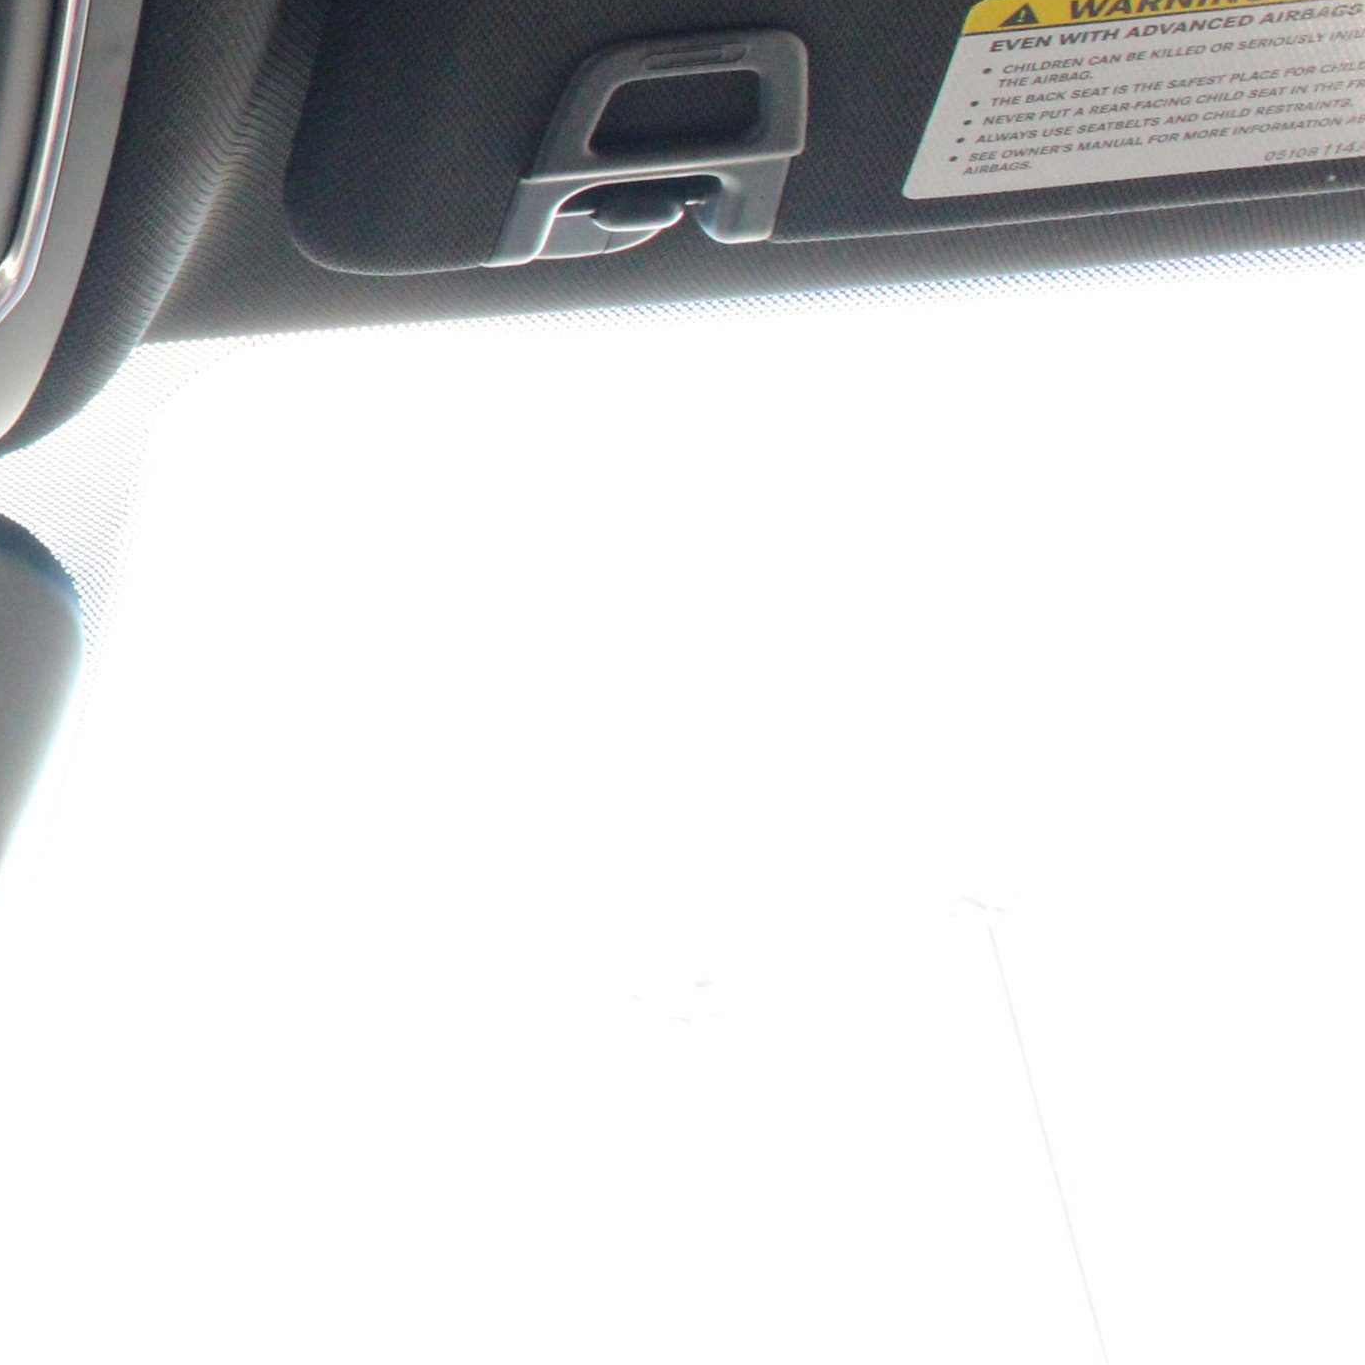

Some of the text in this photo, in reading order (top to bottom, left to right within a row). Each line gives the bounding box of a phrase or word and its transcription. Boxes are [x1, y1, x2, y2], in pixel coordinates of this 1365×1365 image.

[989, 3, 1365, 52] EVEN WITH ADVANCED AIRBAGS
[1003, 58, 1084, 74] CHILDREN
[1088, 53, 1121, 66] CAN
[1126, 50, 1147, 62] BE
[1150, 44, 1207, 59] KILLED
[1210, 42, 1234, 53] OR
[1237, 32, 1326, 50] SERIOUSLY
[991, 95, 1021, 106] THE
[1025, 91, 1067, 104] BACK
[1070, 86, 1110, 99] SEAT
[1112, 84, 1129, 95] IS
[1133, 81, 1164, 93] THE
[1166, 74, 1227, 89] SAFEST
[1229, 69, 1280, 82] PLACE
[1284, 65, 1316, 78] FOR
[998, 70, 1094, 88] THE AIRBAG.
[975, 98, 1354, 143] ALWAYS USE SEATBELTS AND CHILD RESTRAINTS.
[982, 112, 1036, 126] NEVER
[1039, 108, 1071, 120] PUT
[1073, 107, 1085, 116] A
[1089, 96, 1191, 115] REAR-FACING
[1195, 91, 1244, 105] CHILD
[1248, 86, 1287, 99] SEAT
[1290, 85, 1308, 95] IN
[1314, 81, 1345, 92] THE
[968, 151, 998, 162] SEE
[1002, 143, 1073, 159] OWNER'S
[1077, 137, 1143, 151] MANUAL
[1148, 133, 1179, 144] FOR
[1182, 127, 1231, 140] MORE
[1232, 116, 1343, 135] INFORMATION
[962, 160, 1033, 175] AIRBAGS.
